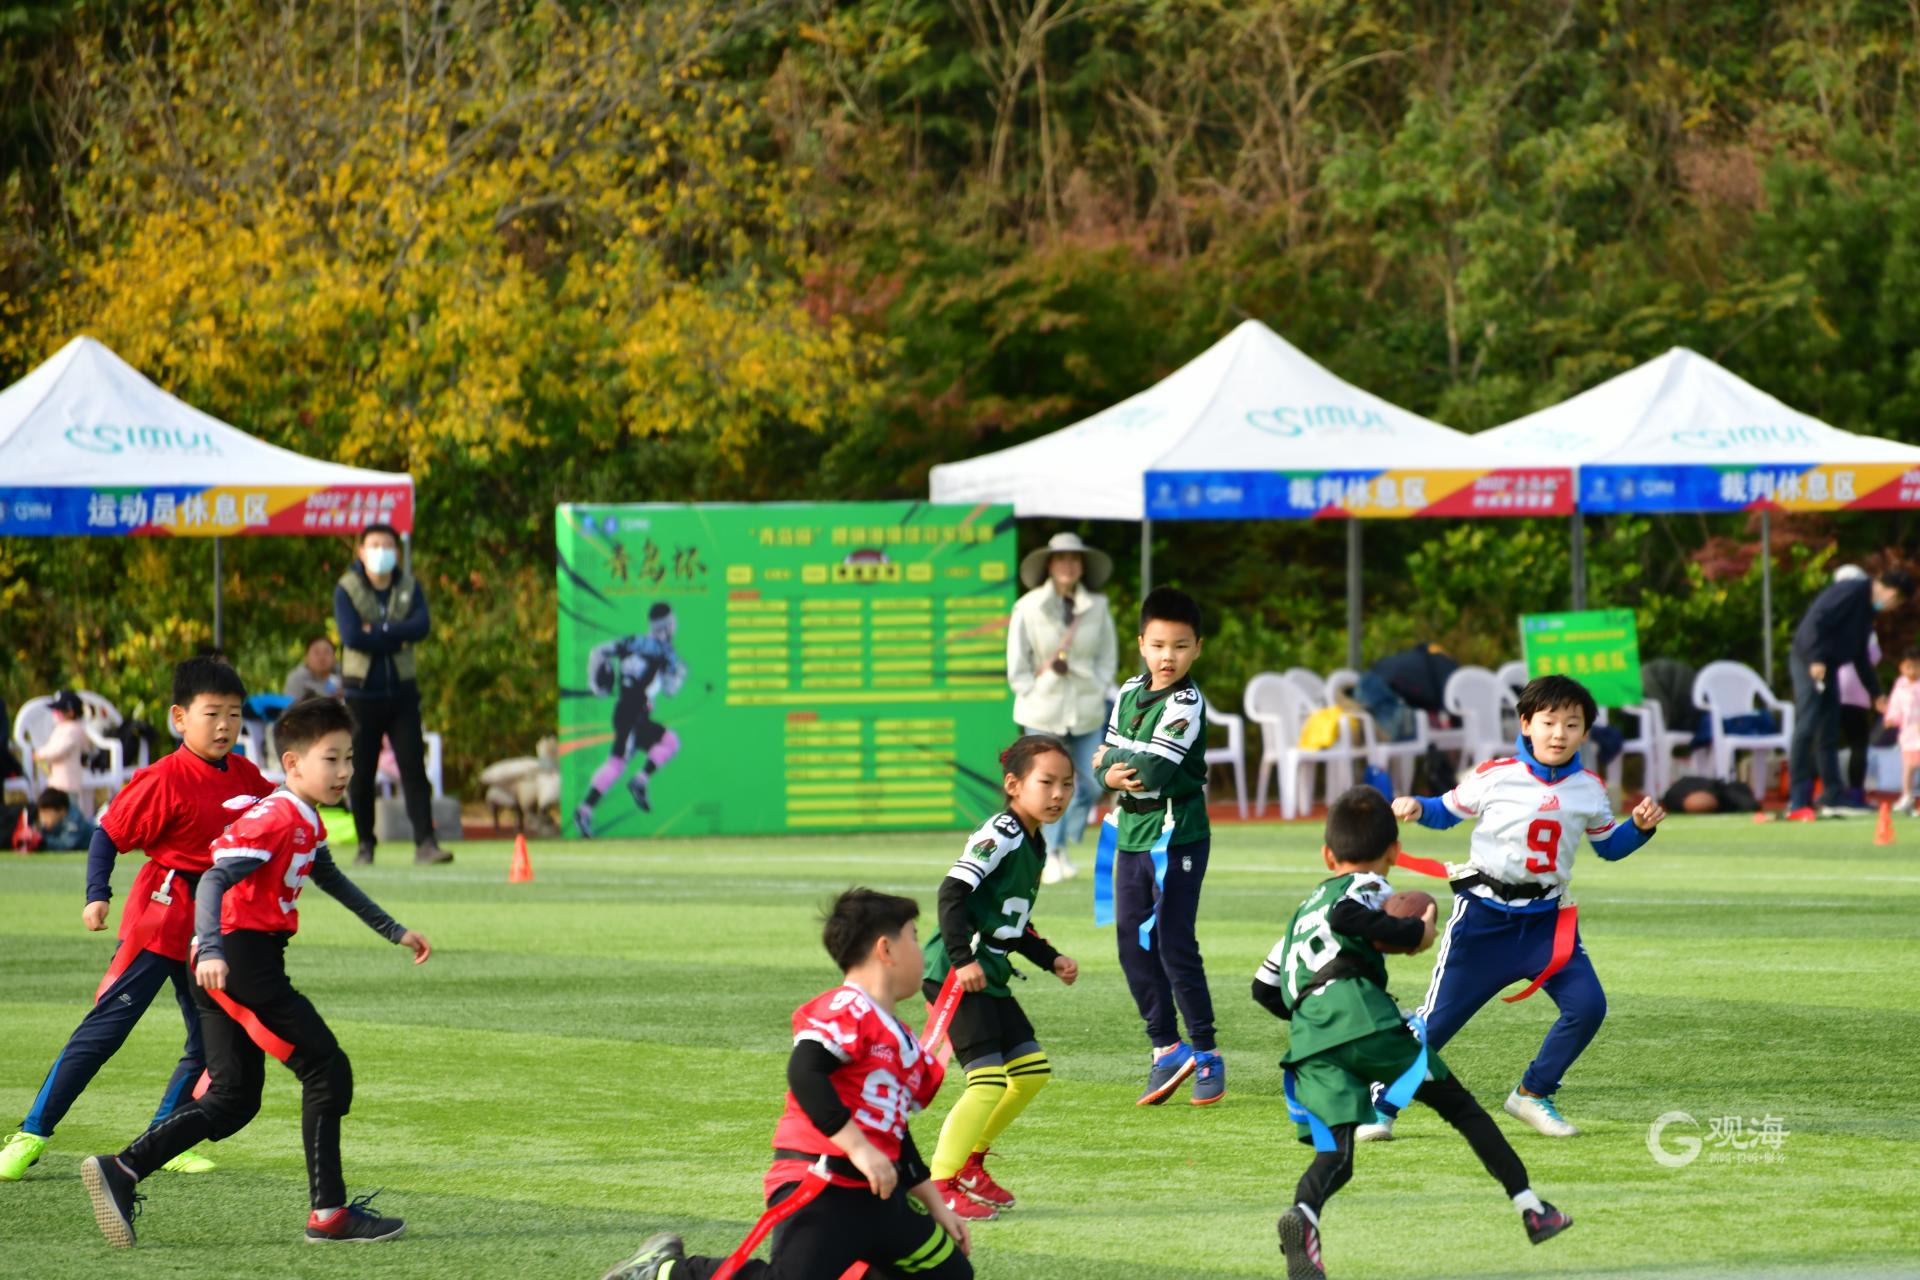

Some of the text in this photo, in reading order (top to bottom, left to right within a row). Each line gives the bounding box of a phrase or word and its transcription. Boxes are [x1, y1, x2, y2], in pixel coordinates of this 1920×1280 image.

[1719, 471, 1857, 502] 裁判休息区
[88, 493, 270, 528] 运动员休息区
[1174, 689, 1197, 701] 53
[994, 814, 1021, 834] 23
[1525, 818, 1562, 874] 9
